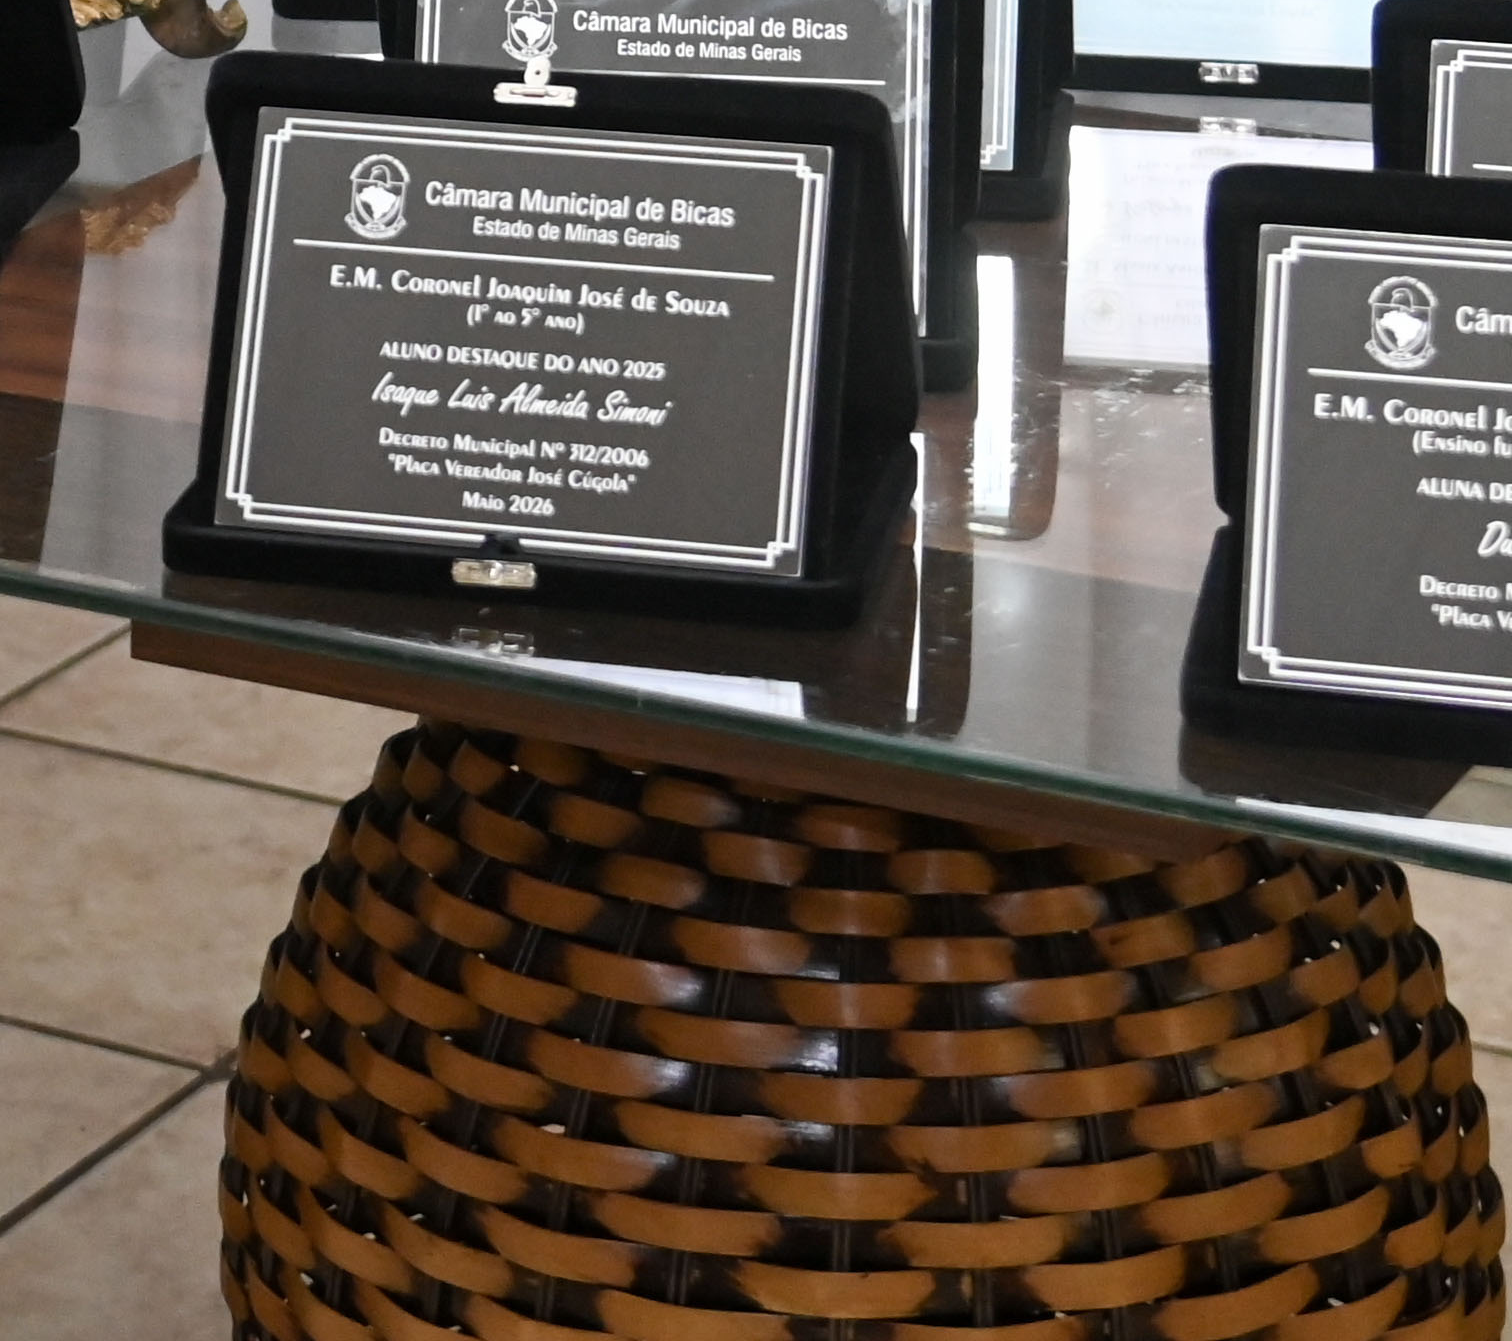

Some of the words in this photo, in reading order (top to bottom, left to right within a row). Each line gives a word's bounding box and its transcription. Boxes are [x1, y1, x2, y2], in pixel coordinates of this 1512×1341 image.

[573, 10, 651, 33] Câmara
[657, 13, 755, 40] Municipal
[761, 17, 786, 38] de
[792, 18, 848, 41] Bicas
[617, 38, 671, 57] Estado
[675, 41, 695, 58] de
[699, 42, 747, 60] Minas
[751, 43, 802, 62] Gerais
[425, 181, 514, 210] Câmara
[520, 187, 631, 221] Municipal
[635, 197, 665, 222] de
[671, 199, 735, 228] Bicas
[472, 215, 534, 239] Estado
[537, 221, 561, 242] de
[564, 222, 619, 246] Minas
[623, 227, 681, 250] Gerais
[330, 264, 382, 290] E.M.
[391, 269, 481, 297] Coronel
[487, 277, 572, 304] Joaquim
[577, 284, 624, 310] José
[631, 287, 658, 312] de
[665, 290, 730, 317] Souza
[379, 341, 443, 363] ALUNO
[446, 345, 540, 371] DESTAQUE
[544, 353, 575, 373] DO
[577, 357, 620, 377] ANO
[623, 360, 666, 381] 2025
[371, 371, 440, 416] Isaque
[447, 378, 496, 411] Luis
[498, 382, 589, 420] Almeida
[596, 390, 673, 426] Simoni
[1314, 393, 1374, 422] E.M.
[1383, 399, 1488, 429] Coronel
[1412, 430, 1490, 456] (Ensino
[1416, 477, 1486, 501] ALUNA
[1419, 574, 1502, 602] Decreto
